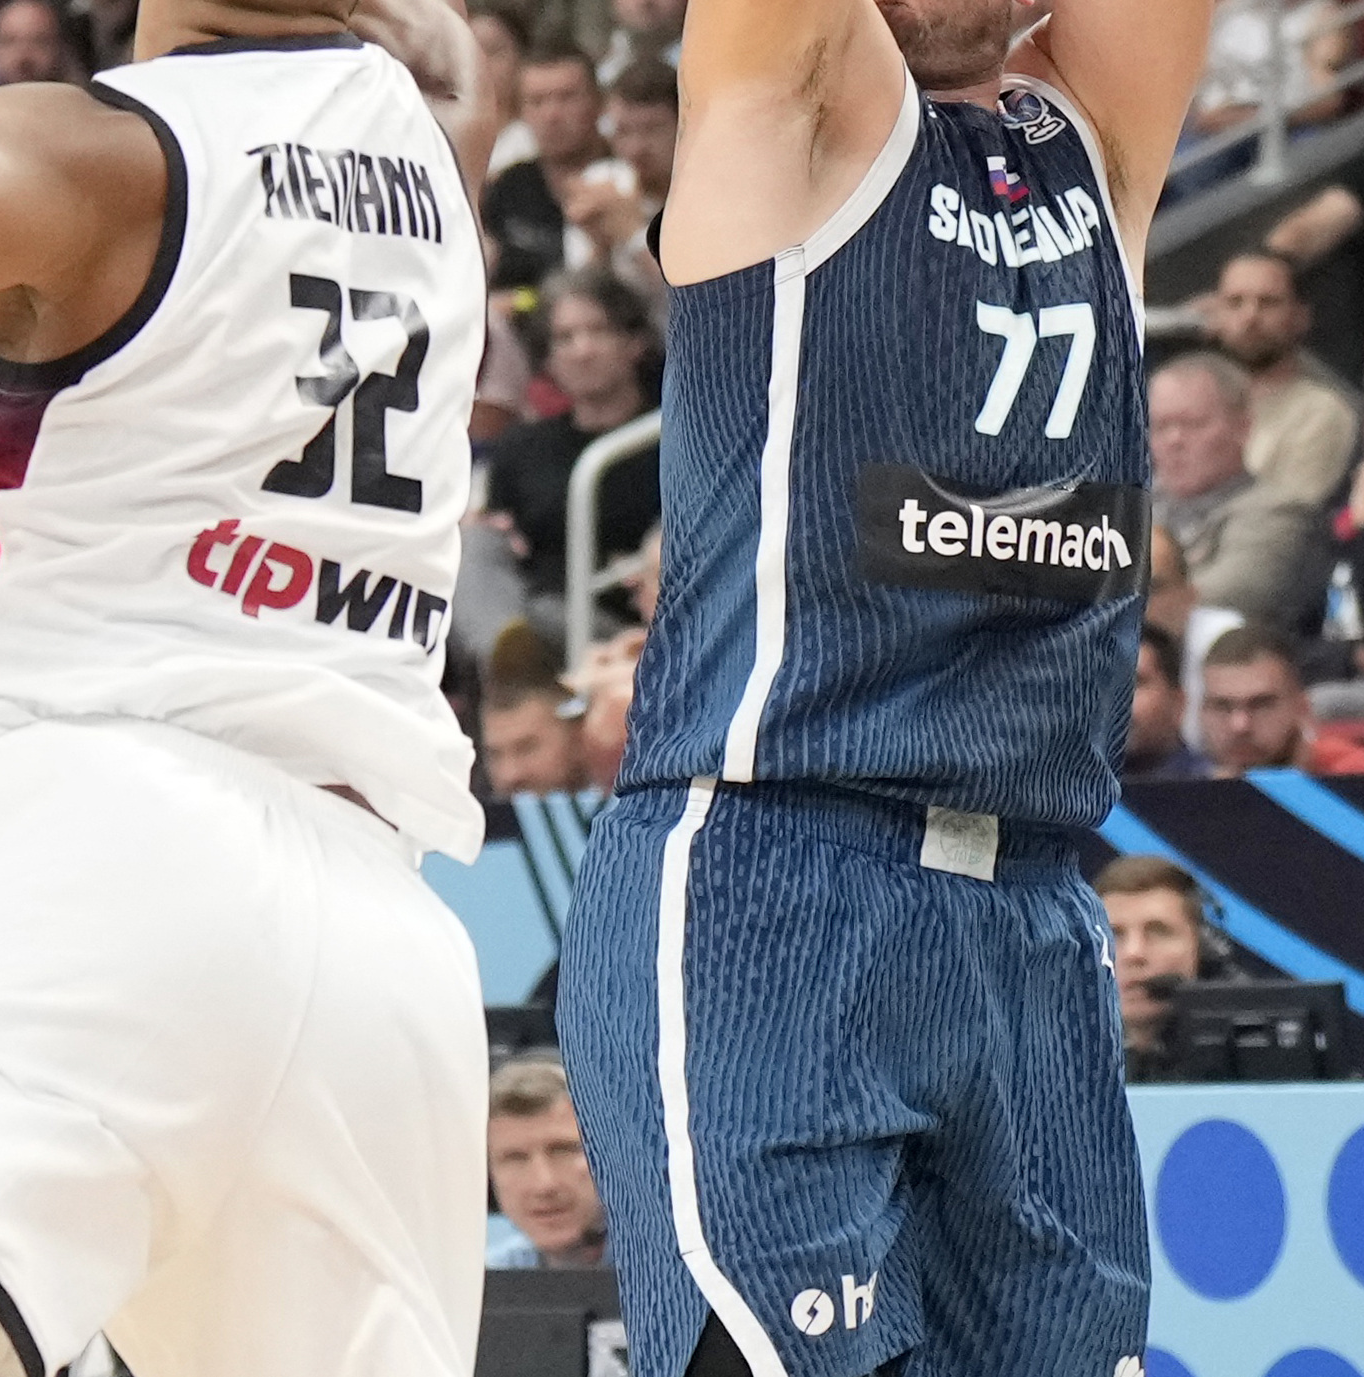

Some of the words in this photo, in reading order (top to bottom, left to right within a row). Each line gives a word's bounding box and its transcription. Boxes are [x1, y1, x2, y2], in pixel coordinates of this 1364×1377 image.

[261, 272, 430, 514] 32
[975, 298, 1096, 439] 77
[898, 498, 1133, 572] telemach
